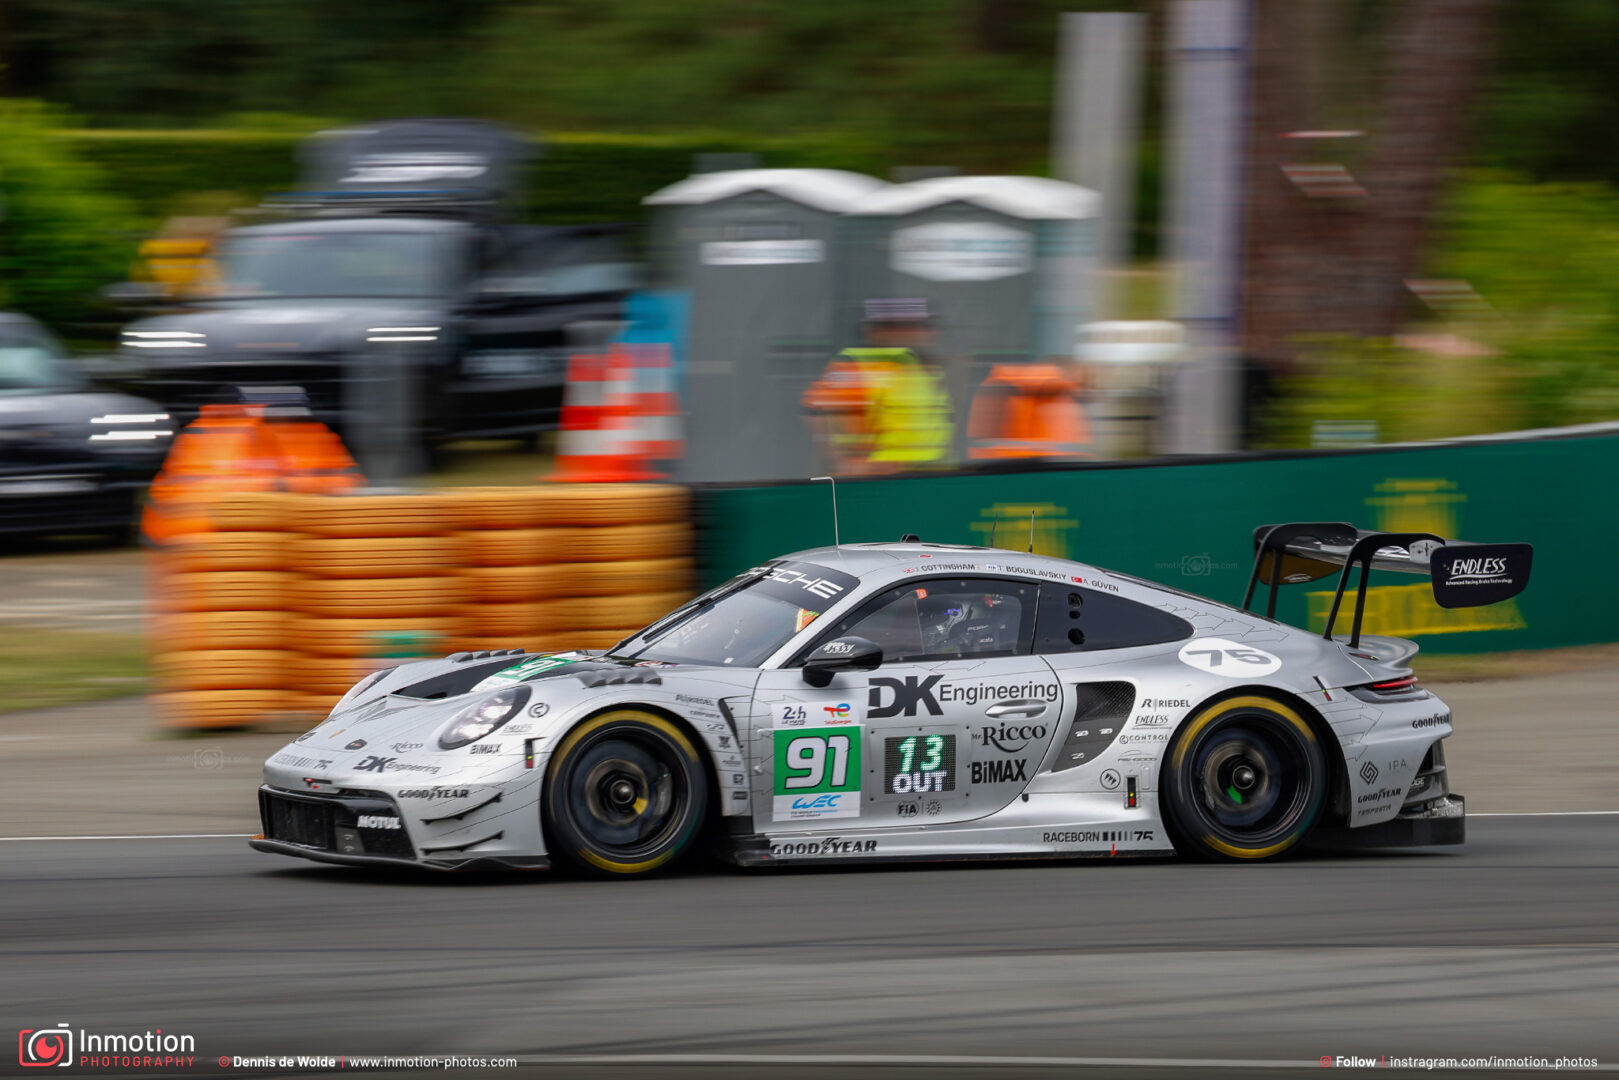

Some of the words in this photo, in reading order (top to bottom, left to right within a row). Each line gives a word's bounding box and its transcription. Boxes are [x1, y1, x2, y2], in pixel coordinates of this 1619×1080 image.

[921, 563, 976, 572] COTTINGHAM
[1006, 565, 1067, 580] BOGUSLAVSKIY
[1450, 557, 1507, 575] ENDLESS
[1092, 579, 1119, 593] GÜVEN
[1186, 650, 1272, 667] 75
[866, 674, 945, 719] DK
[938, 681, 1058, 706] Engineering
[1158, 699, 1191, 708] RIEDEL
[782, 705, 807, 720] 24h
[1135, 714, 1169, 725] ENDLESS
[981, 722, 1047, 753] Ricco
[784, 734, 850, 790] 91
[897, 734, 945, 774] 13
[352, 755, 398, 773] DK
[386, 761, 441, 774] Engineering
[971, 758, 1028, 785] BiMAX
[892, 770, 948, 794] OUT
[397, 785, 470, 800] GOODYEAR
[1357, 788, 1402, 804] GOODYEAR
[791, 794, 843, 810] WEC
[357, 815, 401, 830] MOTUL
[1043, 831, 1100, 843] RACEBORN
[1133, 830, 1154, 841] 75
[770, 837, 878, 856] GOODYEAR
